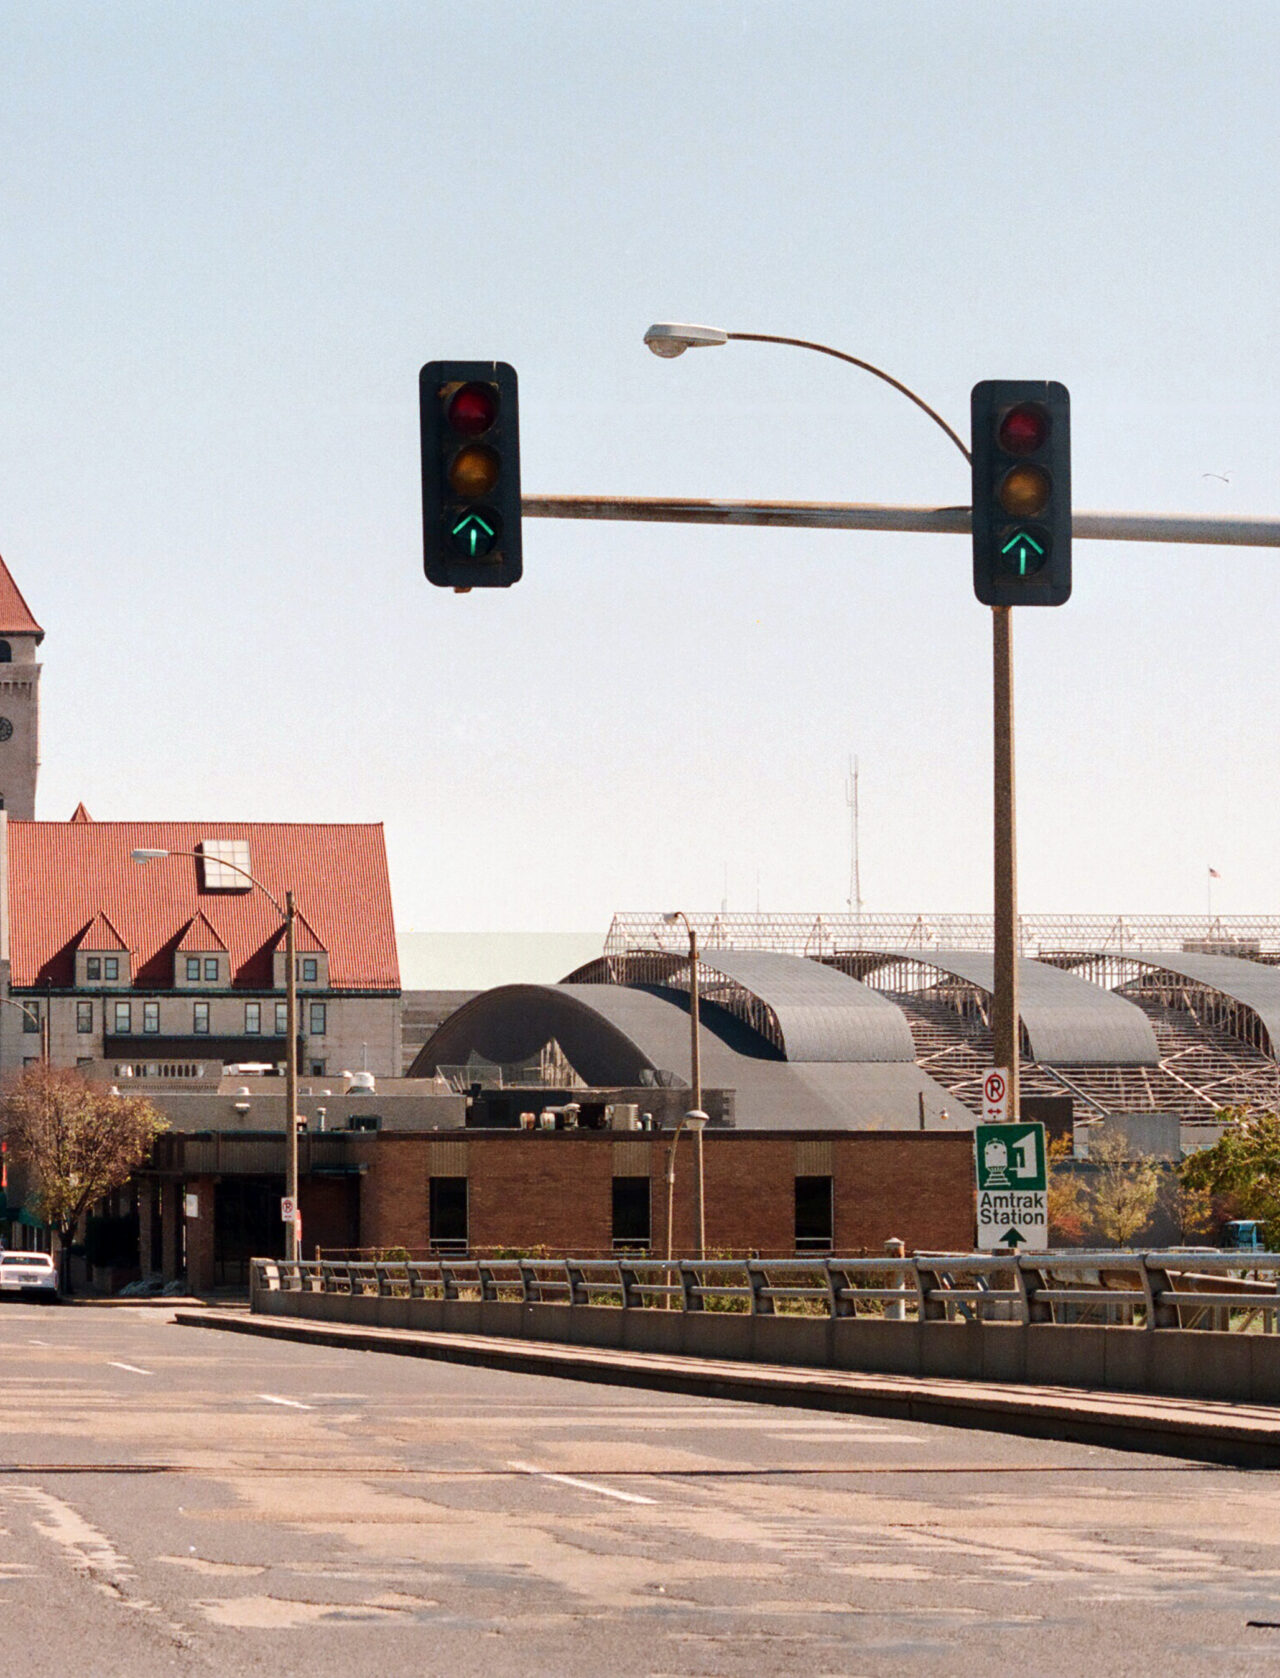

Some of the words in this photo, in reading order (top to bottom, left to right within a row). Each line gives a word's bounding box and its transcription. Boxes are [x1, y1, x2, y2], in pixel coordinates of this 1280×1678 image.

[991, 1079, 1001, 1097] P
[981, 1192, 1043, 1208] Amtrak
[981, 1208, 1045, 1225] Station
